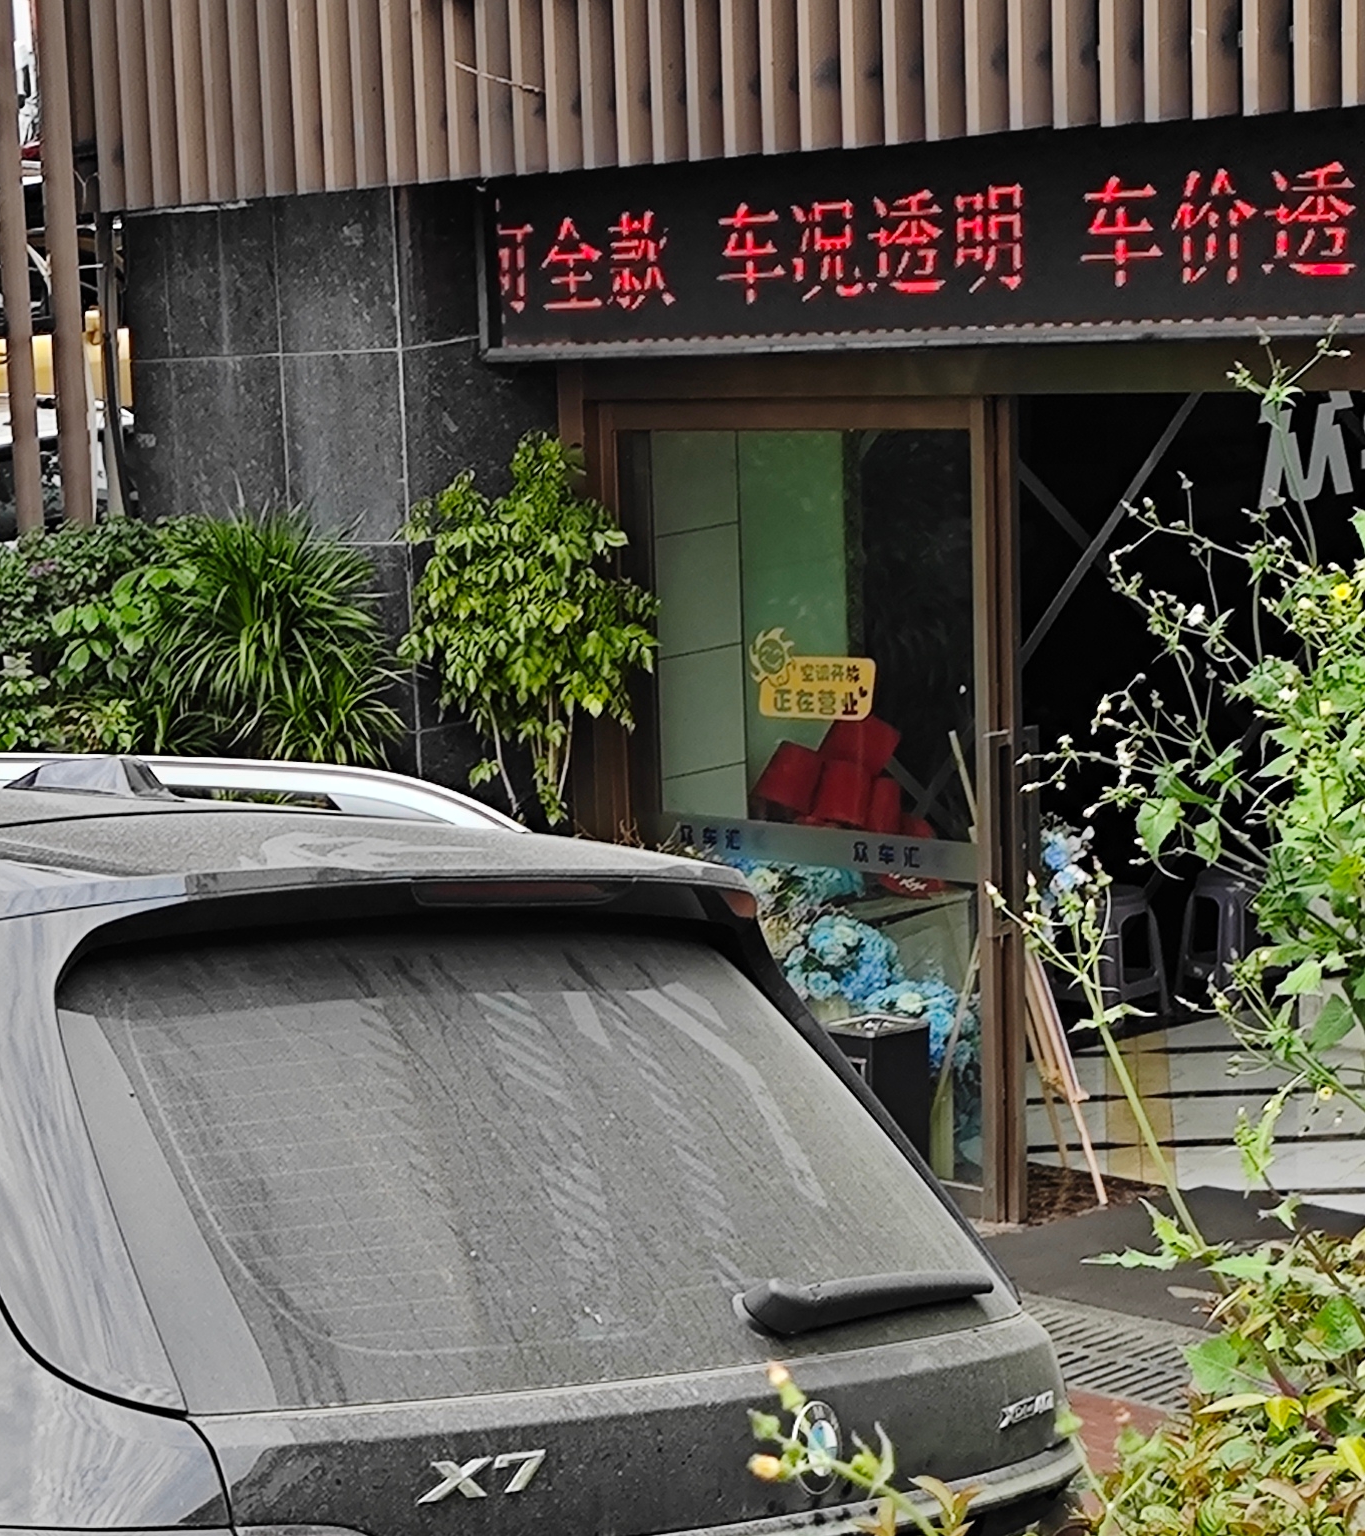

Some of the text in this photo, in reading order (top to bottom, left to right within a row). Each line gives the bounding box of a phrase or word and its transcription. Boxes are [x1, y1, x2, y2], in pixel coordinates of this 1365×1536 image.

[716, 182, 1024, 306] 车况透明
[1079, 160, 1357, 288] 车价透
[773, 688, 860, 716] 正在营业
[852, 840, 921, 868] 众车汇
[415, 1448, 547, 1506] X7
